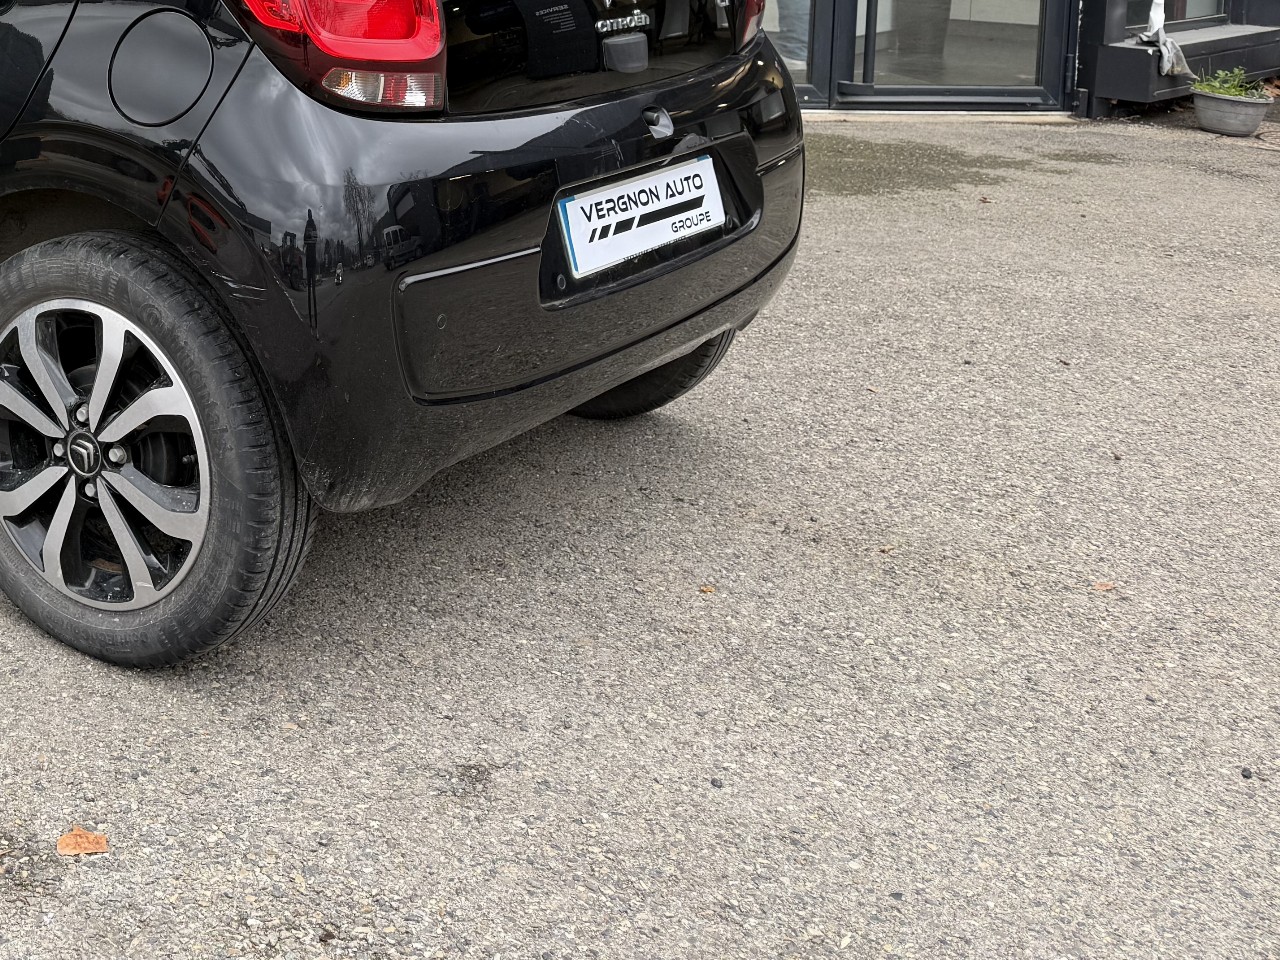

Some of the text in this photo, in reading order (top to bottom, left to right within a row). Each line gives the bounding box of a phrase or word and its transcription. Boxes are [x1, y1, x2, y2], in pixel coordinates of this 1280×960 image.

[580, 173, 704, 223] VERGNON AUTO
[671, 210, 712, 233] GROUPE
